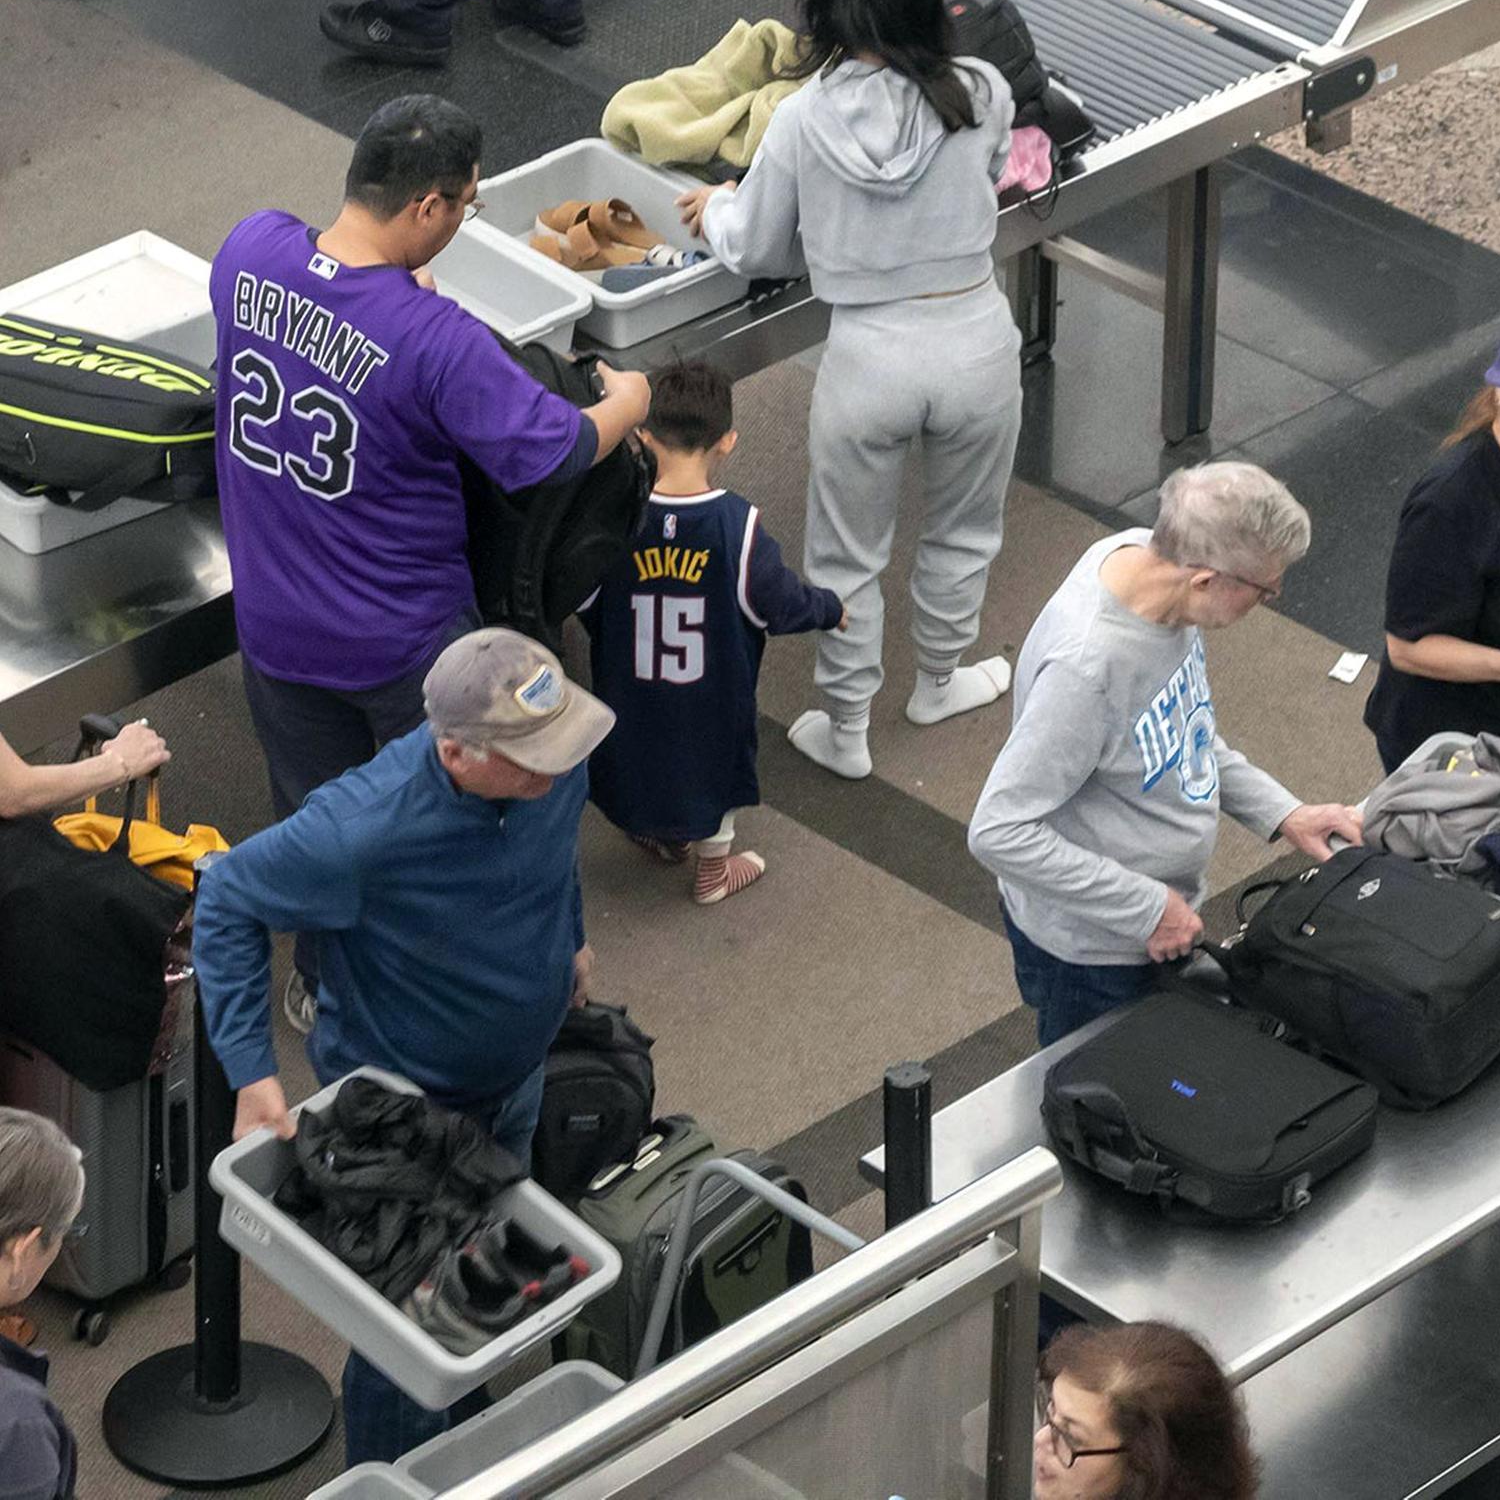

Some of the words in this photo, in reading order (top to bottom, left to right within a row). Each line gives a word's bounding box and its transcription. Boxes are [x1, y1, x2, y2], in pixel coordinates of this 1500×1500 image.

[0, 332, 202, 396] DUNLO
[234, 270, 389, 396] BRYANT
[229, 348, 358, 501] 23
[631, 594, 706, 685] 15
